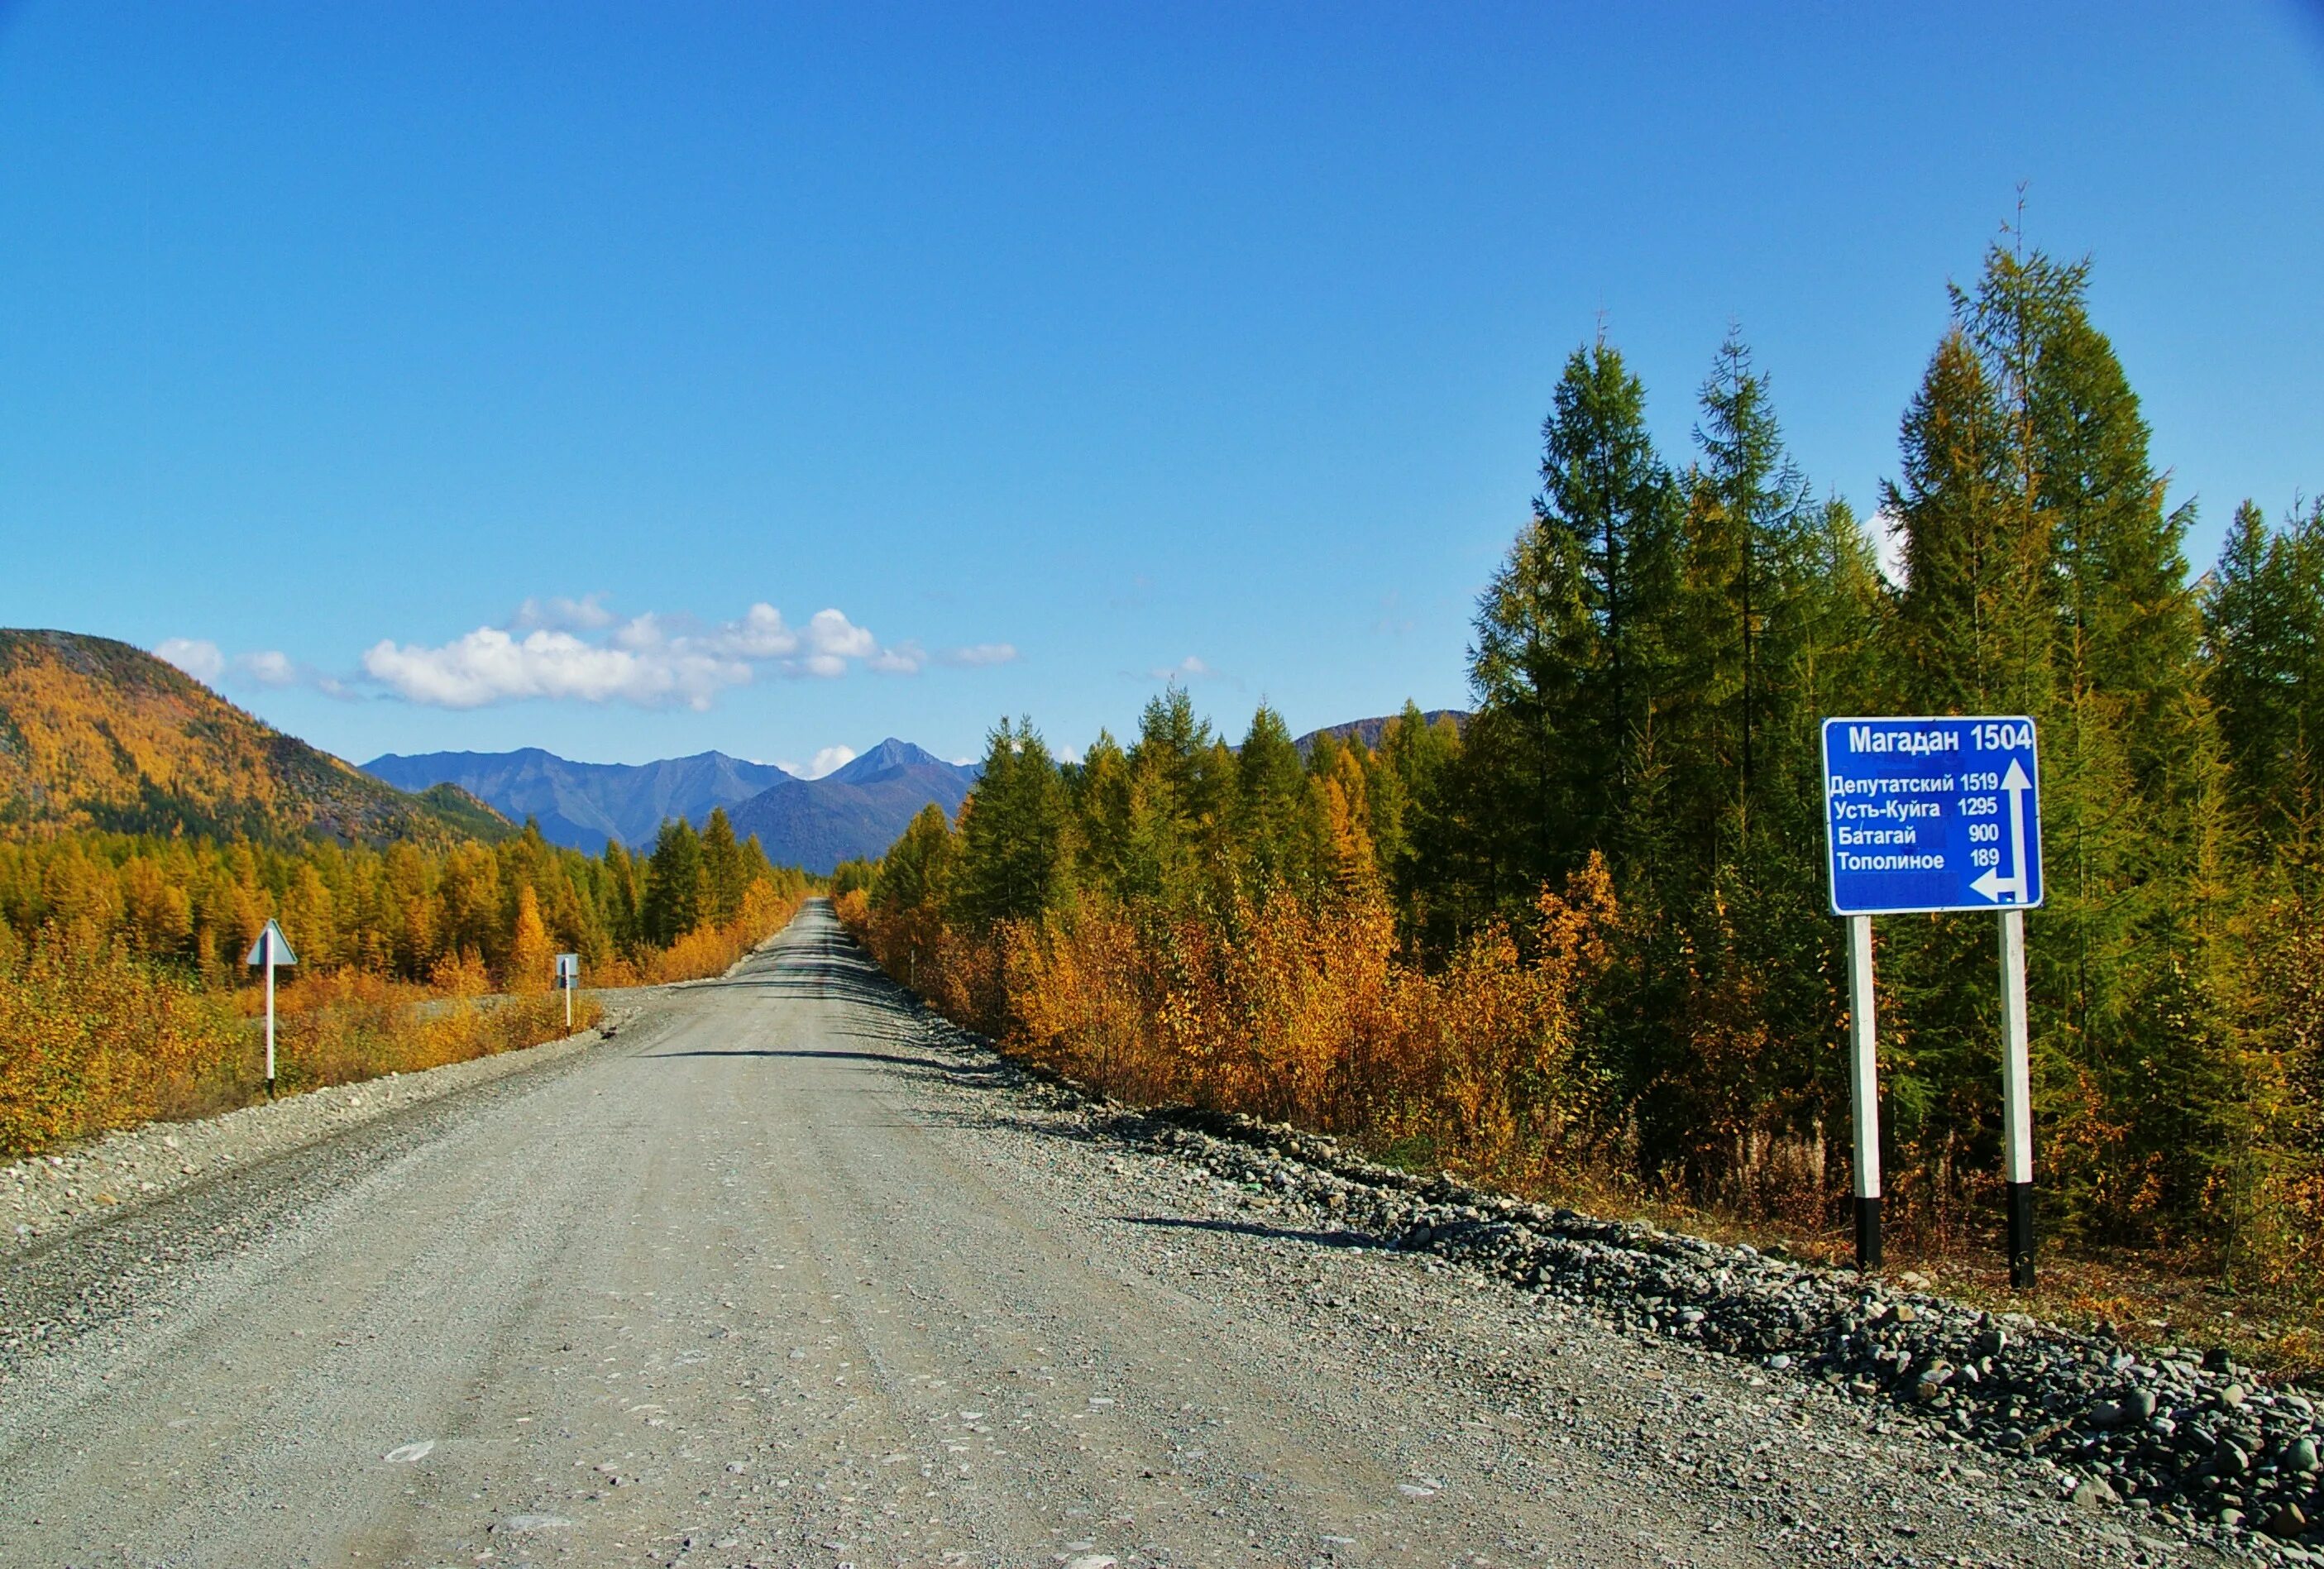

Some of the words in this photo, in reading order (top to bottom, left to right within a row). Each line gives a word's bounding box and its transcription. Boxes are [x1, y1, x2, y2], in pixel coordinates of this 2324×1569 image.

[1848, 725, 1959, 756] Магадан
[1970, 724, 2032, 751] 1504
[1829, 773, 1954, 797] Депутатский
[1960, 772, 1999, 792] 1519
[1834, 799, 1941, 822] Усть-Куйга
[1958, 796, 1998, 816] 1295
[1838, 825, 1916, 845] Батагай
[1968, 824, 1999, 843] 900
[1836, 852, 1945, 870] Тополиное
[1969, 848, 2000, 867] 189
